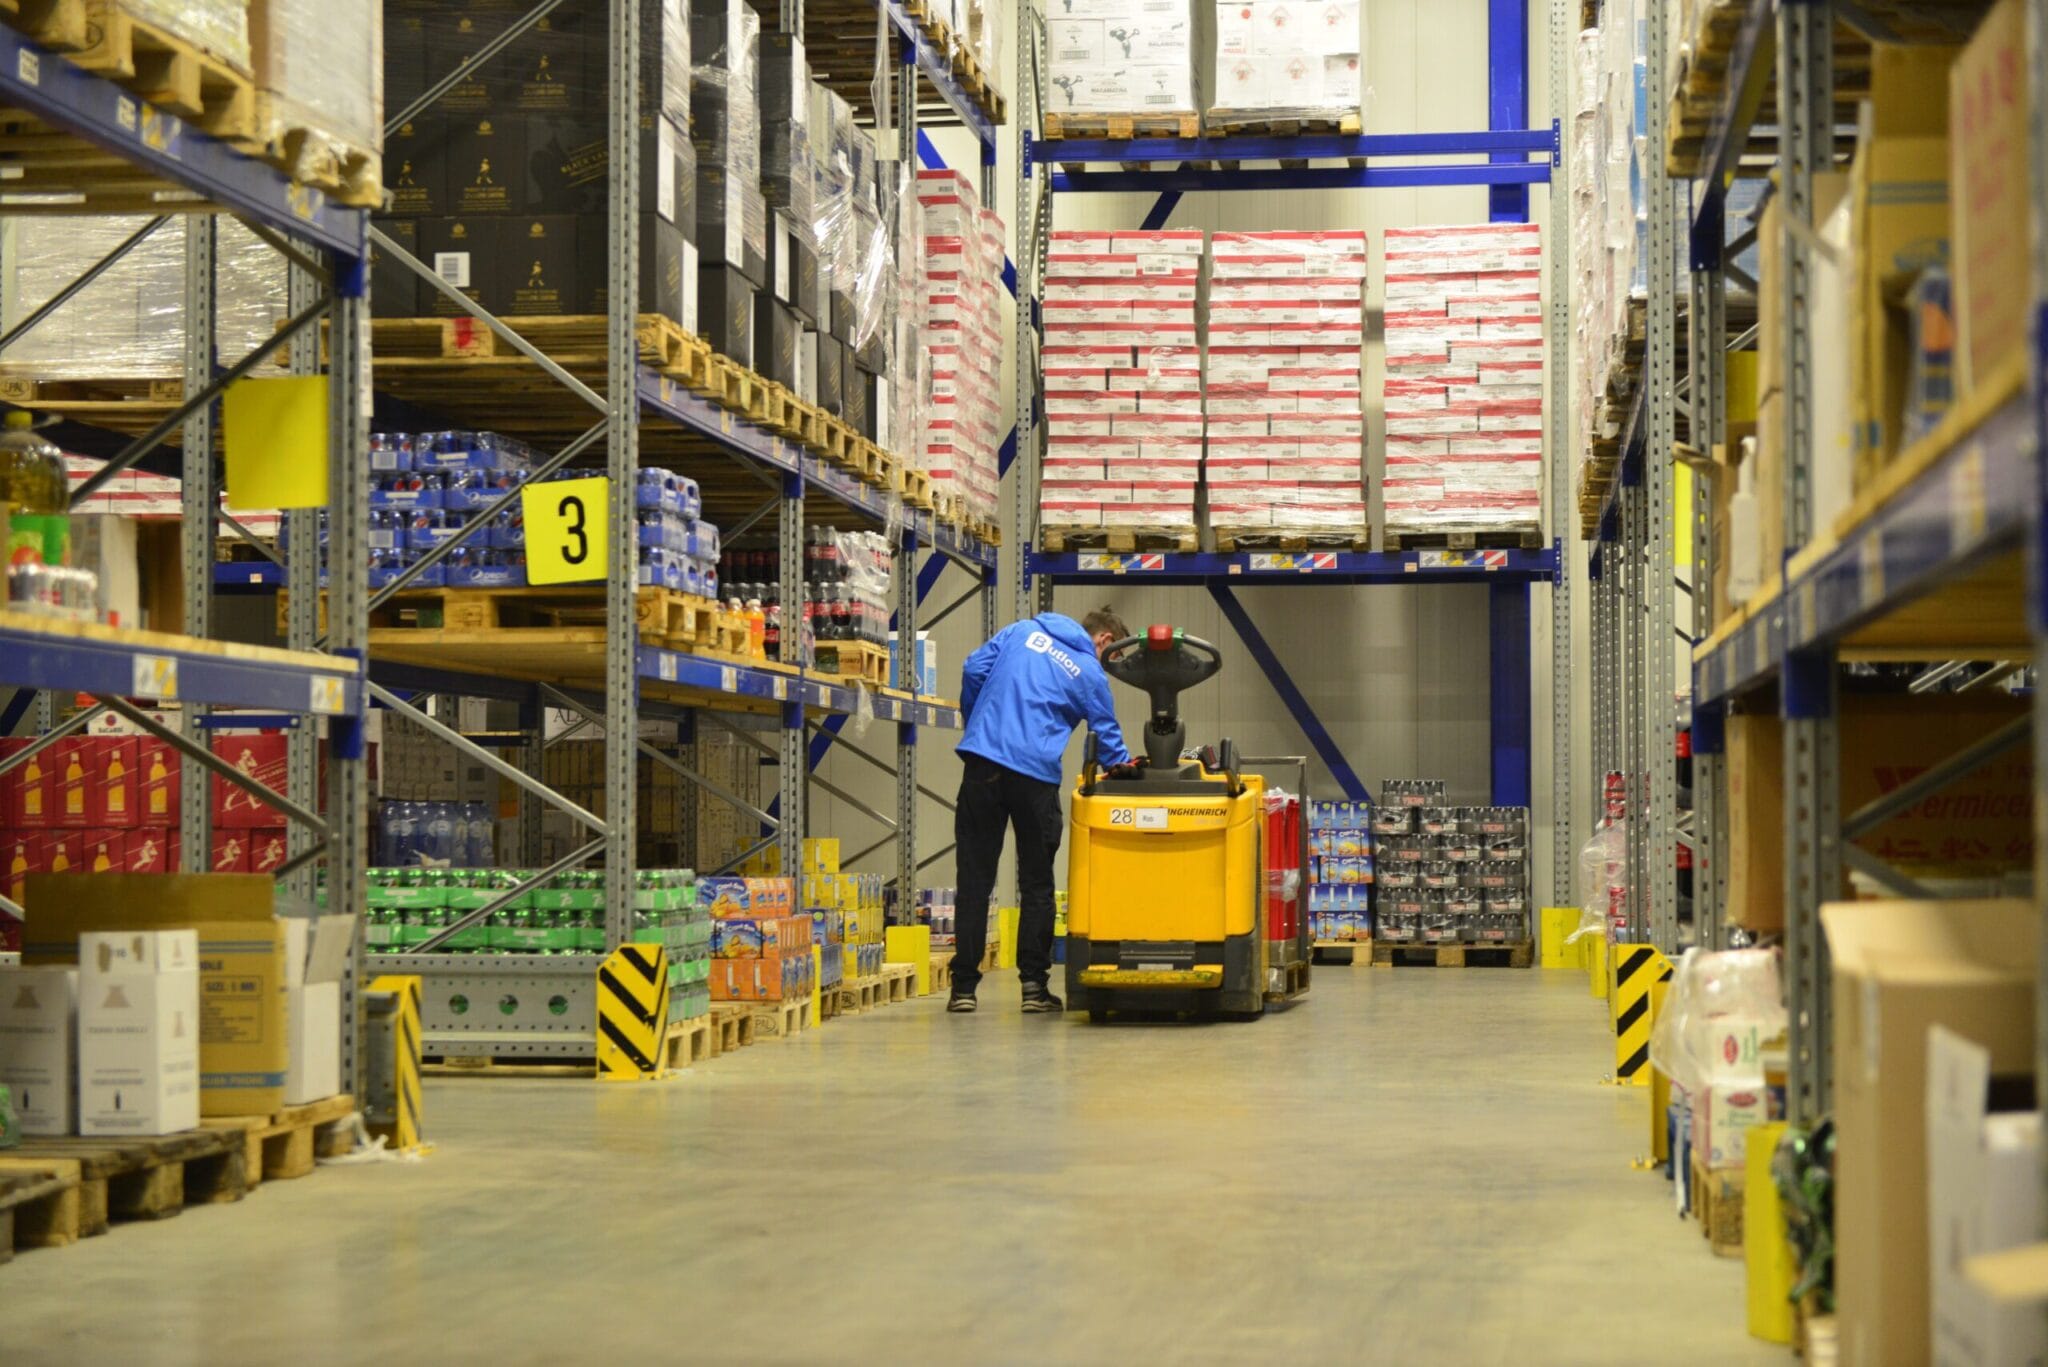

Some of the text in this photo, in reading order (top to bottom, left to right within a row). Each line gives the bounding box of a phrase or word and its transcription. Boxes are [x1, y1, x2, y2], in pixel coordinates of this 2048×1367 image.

[558, 496, 588, 565] 3
[1111, 808, 1133, 824] 28
[1167, 807, 1227, 816] NGHEINRICH
